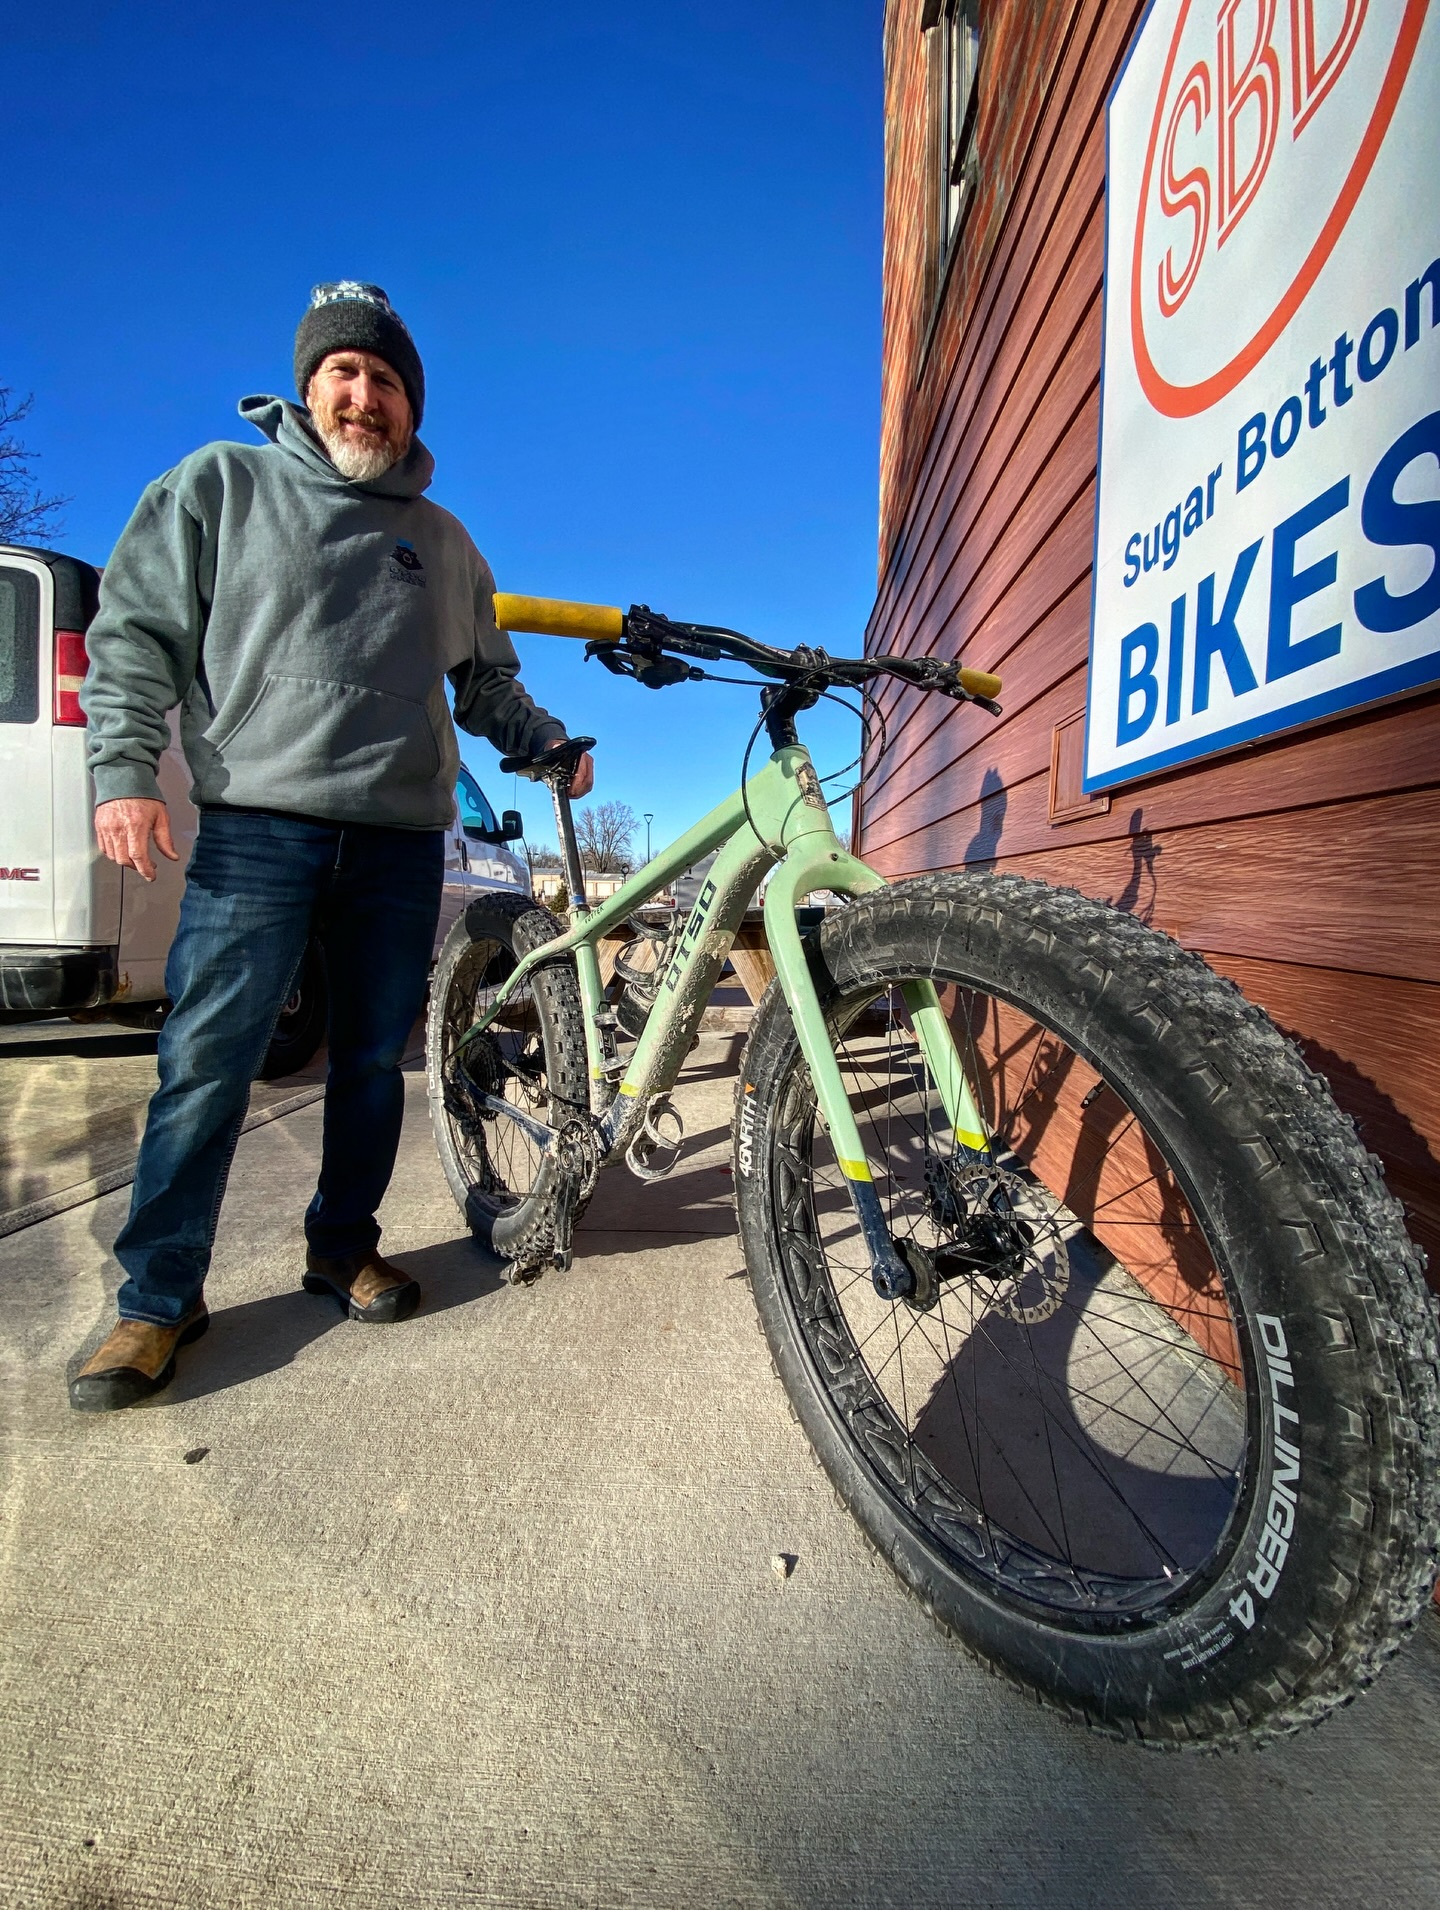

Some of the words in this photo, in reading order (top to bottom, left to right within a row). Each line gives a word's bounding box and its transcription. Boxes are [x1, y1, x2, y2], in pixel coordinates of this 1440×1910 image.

[1116, 409, 1440, 748] BIKES
[1123, 462, 1224, 588] Sugar
[665, 879, 717, 993] OTSO
[428, 1010, 436, 1090] DILLINGER
[738, 1094, 757, 1178] 45NRTH
[1247, 1312, 1301, 1599] DILLINGER
[1228, 1589, 1256, 1630] 4
